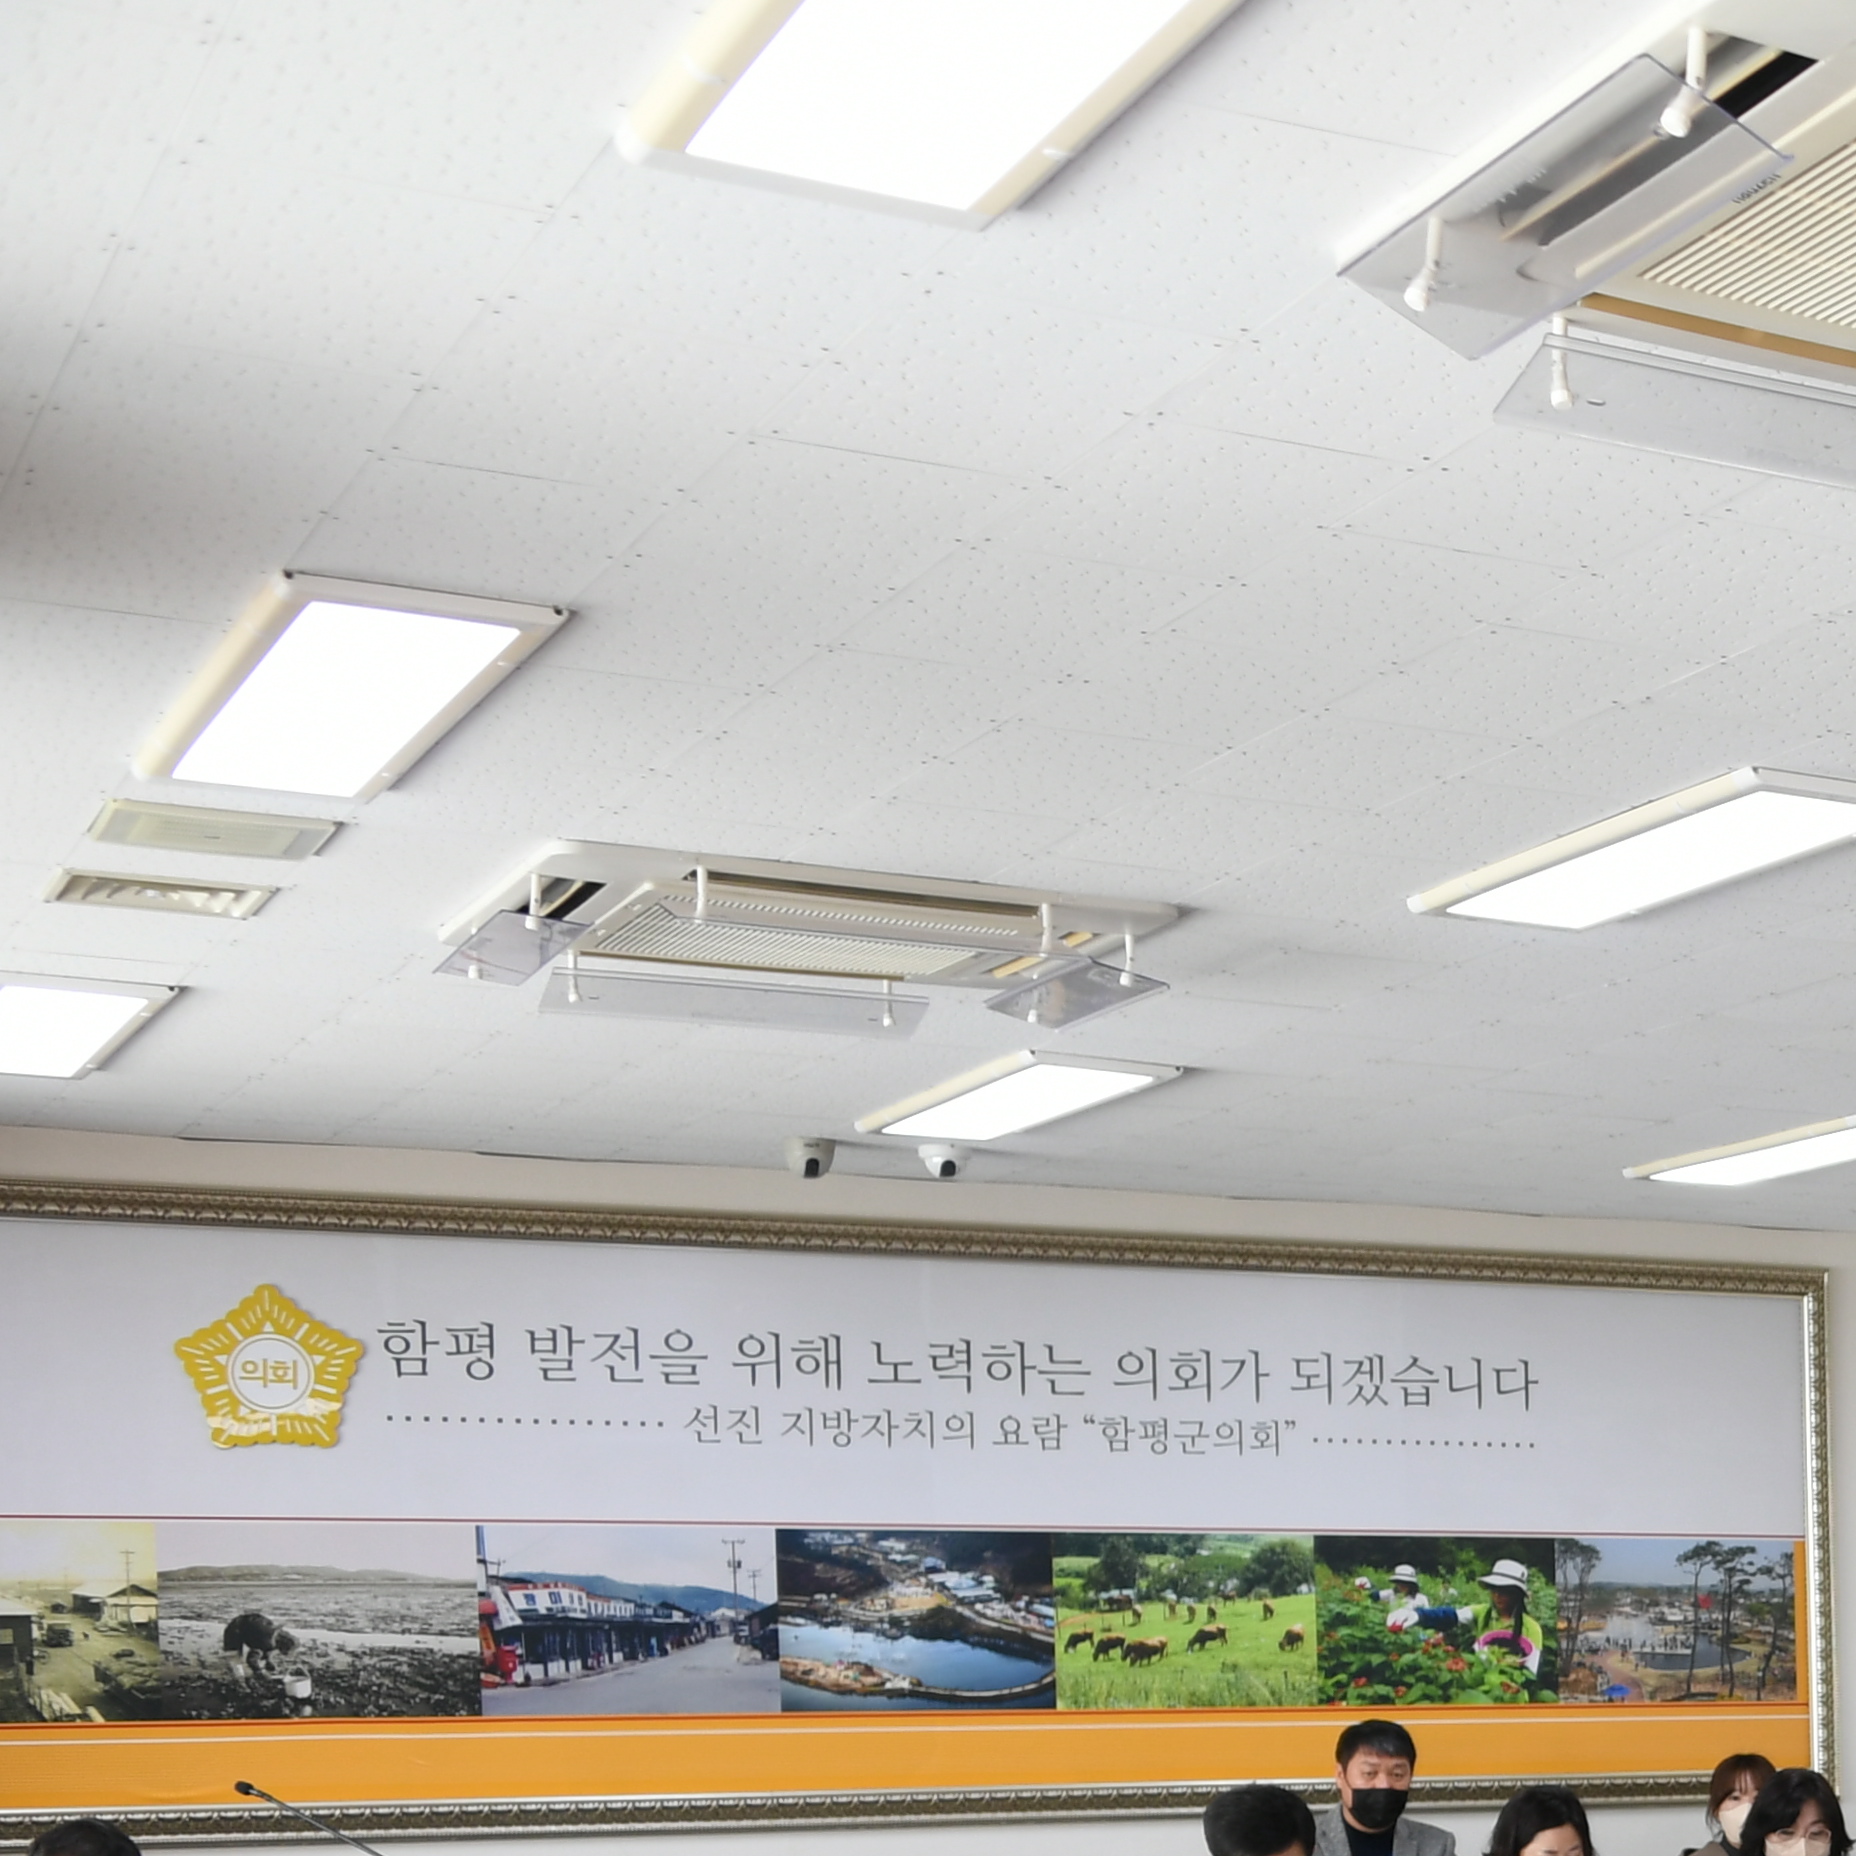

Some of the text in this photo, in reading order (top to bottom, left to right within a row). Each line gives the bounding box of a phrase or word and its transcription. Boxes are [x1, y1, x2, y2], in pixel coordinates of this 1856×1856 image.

[239, 1357, 300, 1389] 의회
[376, 1318, 1540, 1412] 함평 발전을 위해 노력하는 의회가 되겠습니다
[684, 1403, 763, 1445] 선진
[780, 1407, 976, 1450] 지방자치의
[992, 1412, 1069, 1451] 요람
